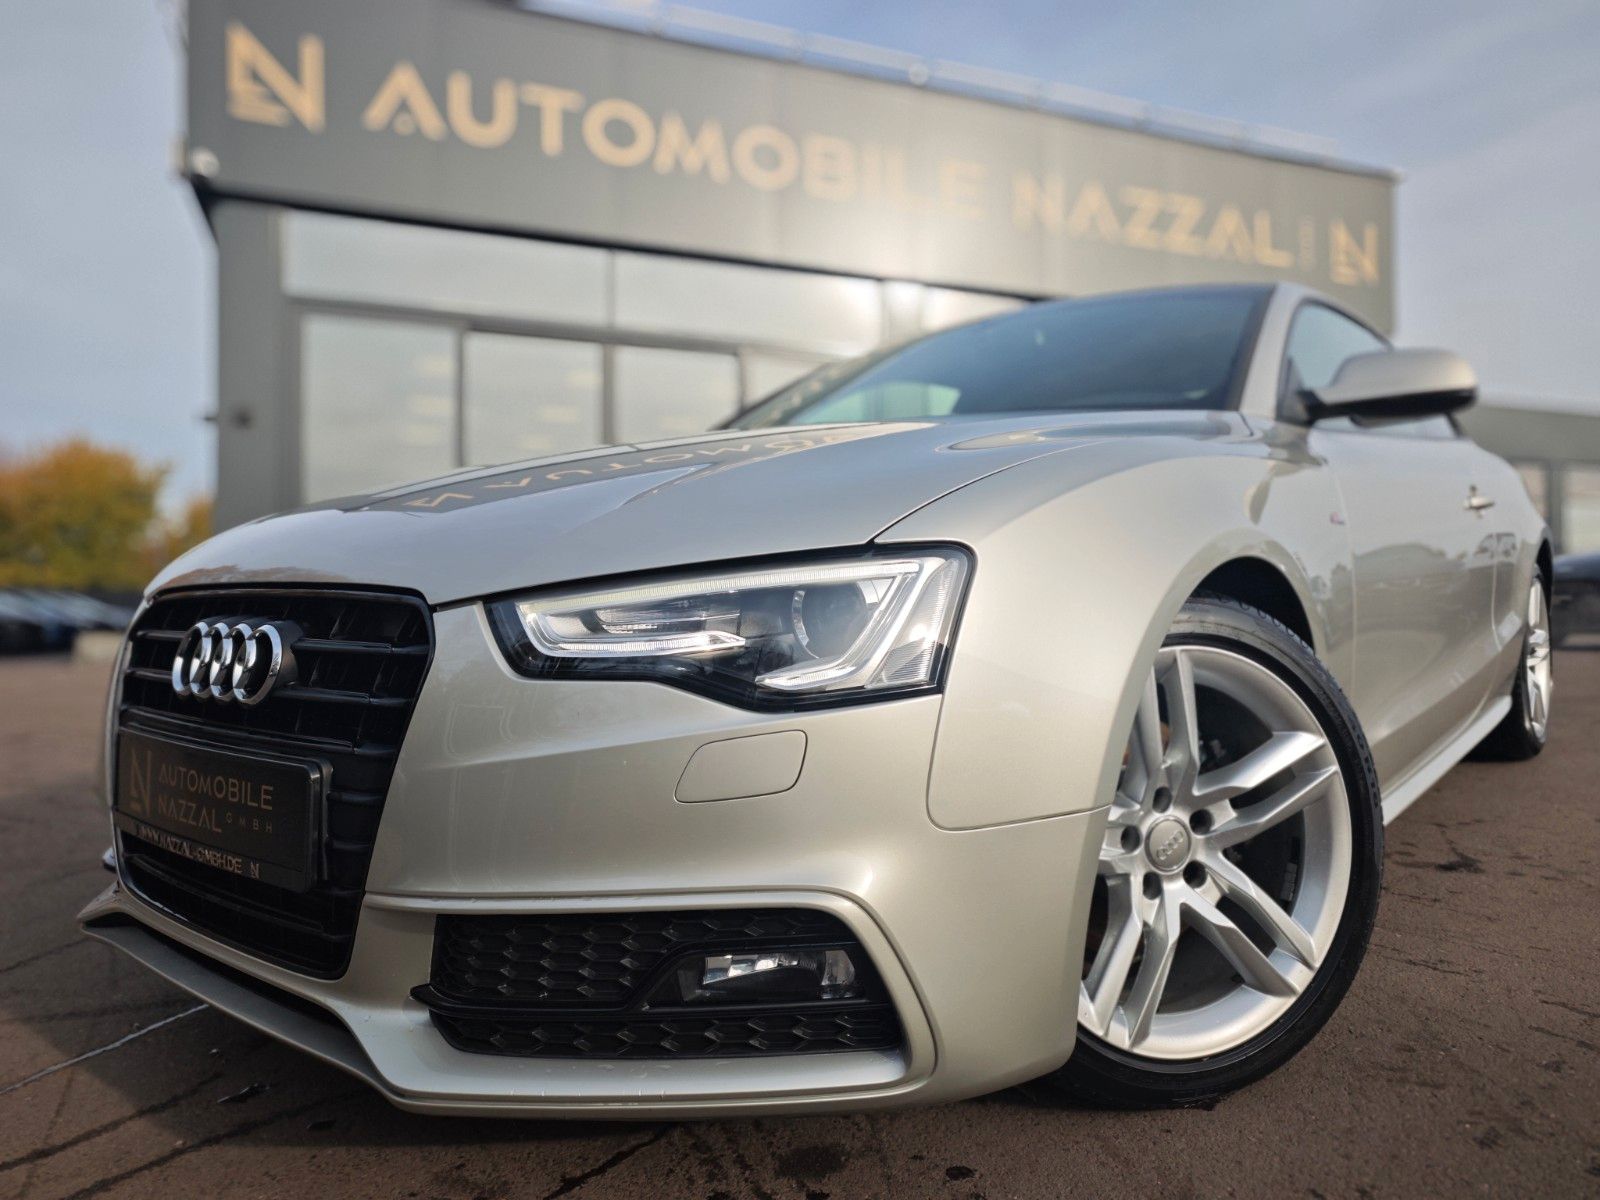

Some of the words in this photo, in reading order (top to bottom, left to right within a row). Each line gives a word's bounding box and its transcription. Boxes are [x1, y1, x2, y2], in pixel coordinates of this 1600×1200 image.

[362, 61, 988, 220] AUTOMOBILE
[1010, 168, 1295, 269] NAZZAL
[158, 762, 274, 811] AUTOMOBILE
[158, 794, 222, 834] NAZZAL
